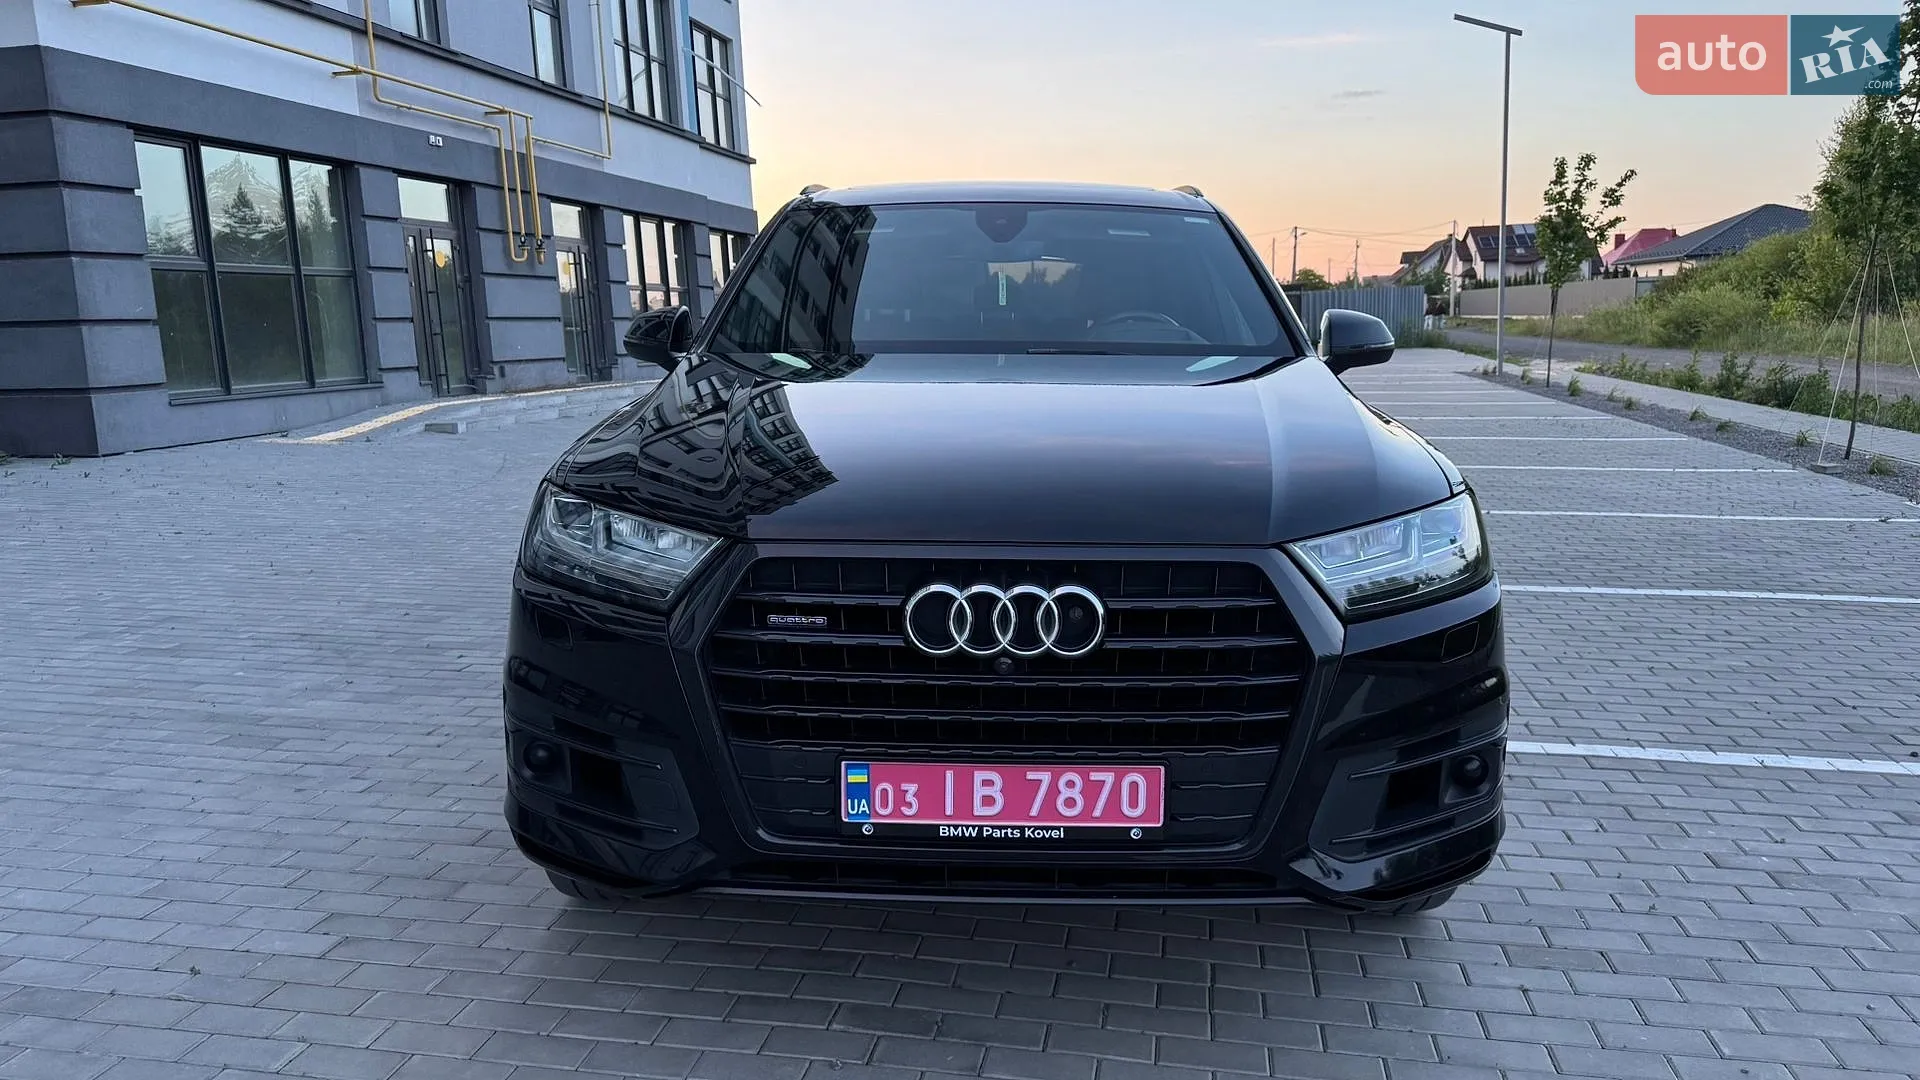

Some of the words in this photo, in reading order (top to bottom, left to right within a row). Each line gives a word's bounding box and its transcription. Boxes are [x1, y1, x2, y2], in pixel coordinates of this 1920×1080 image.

[769, 616, 824, 624] quattro
[874, 782, 919, 817] 03
[944, 770, 1005, 817] IB
[1025, 770, 1147, 818] 7870
[847, 799, 870, 815] UA
[939, 825, 979, 838] BMW
[983, 826, 1020, 839] Parts
[1024, 827, 1064, 839] Kovel
